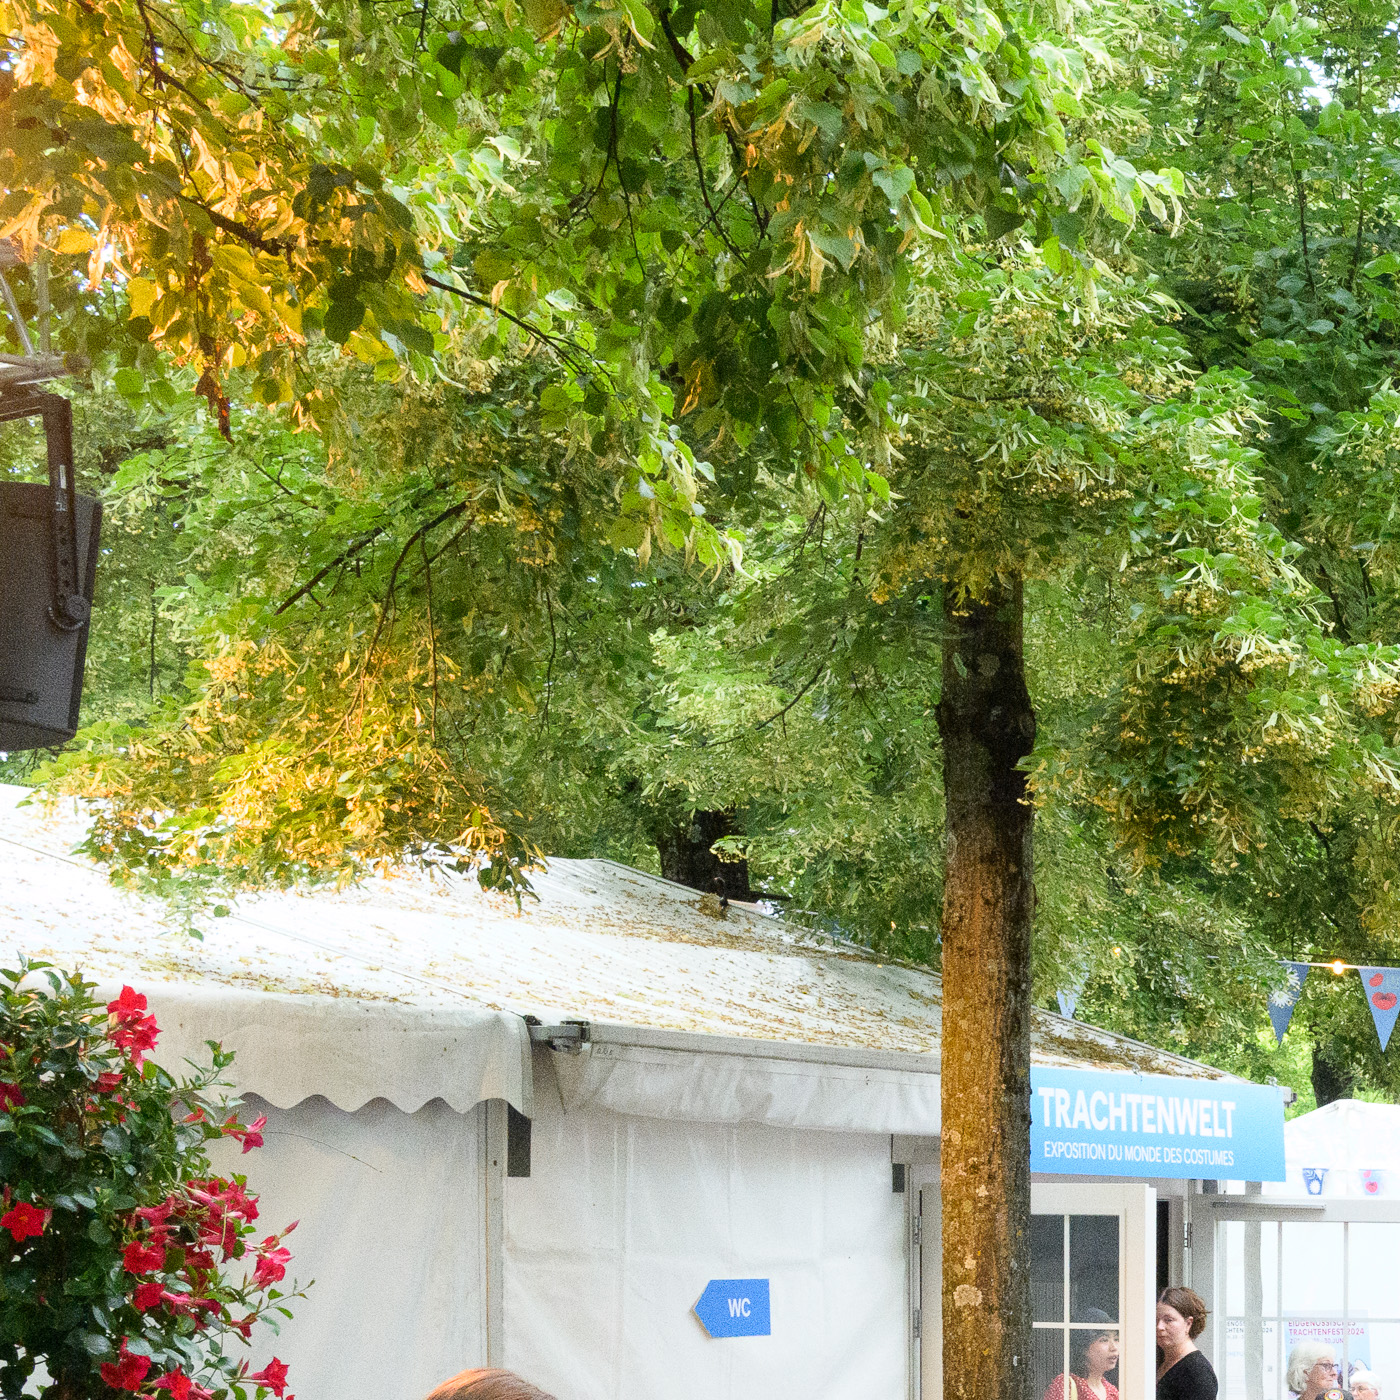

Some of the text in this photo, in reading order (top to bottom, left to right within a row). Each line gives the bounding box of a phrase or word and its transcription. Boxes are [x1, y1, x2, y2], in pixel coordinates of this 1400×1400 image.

[1038, 1087, 1236, 1138] TRACHTENWELT
[1044, 1141, 1235, 1167] EXPOSITION DU MONDE DES COSTUMES
[728, 1297, 751, 1318] WC
[1288, 1328, 1344, 1336] TRACHTENFEST
